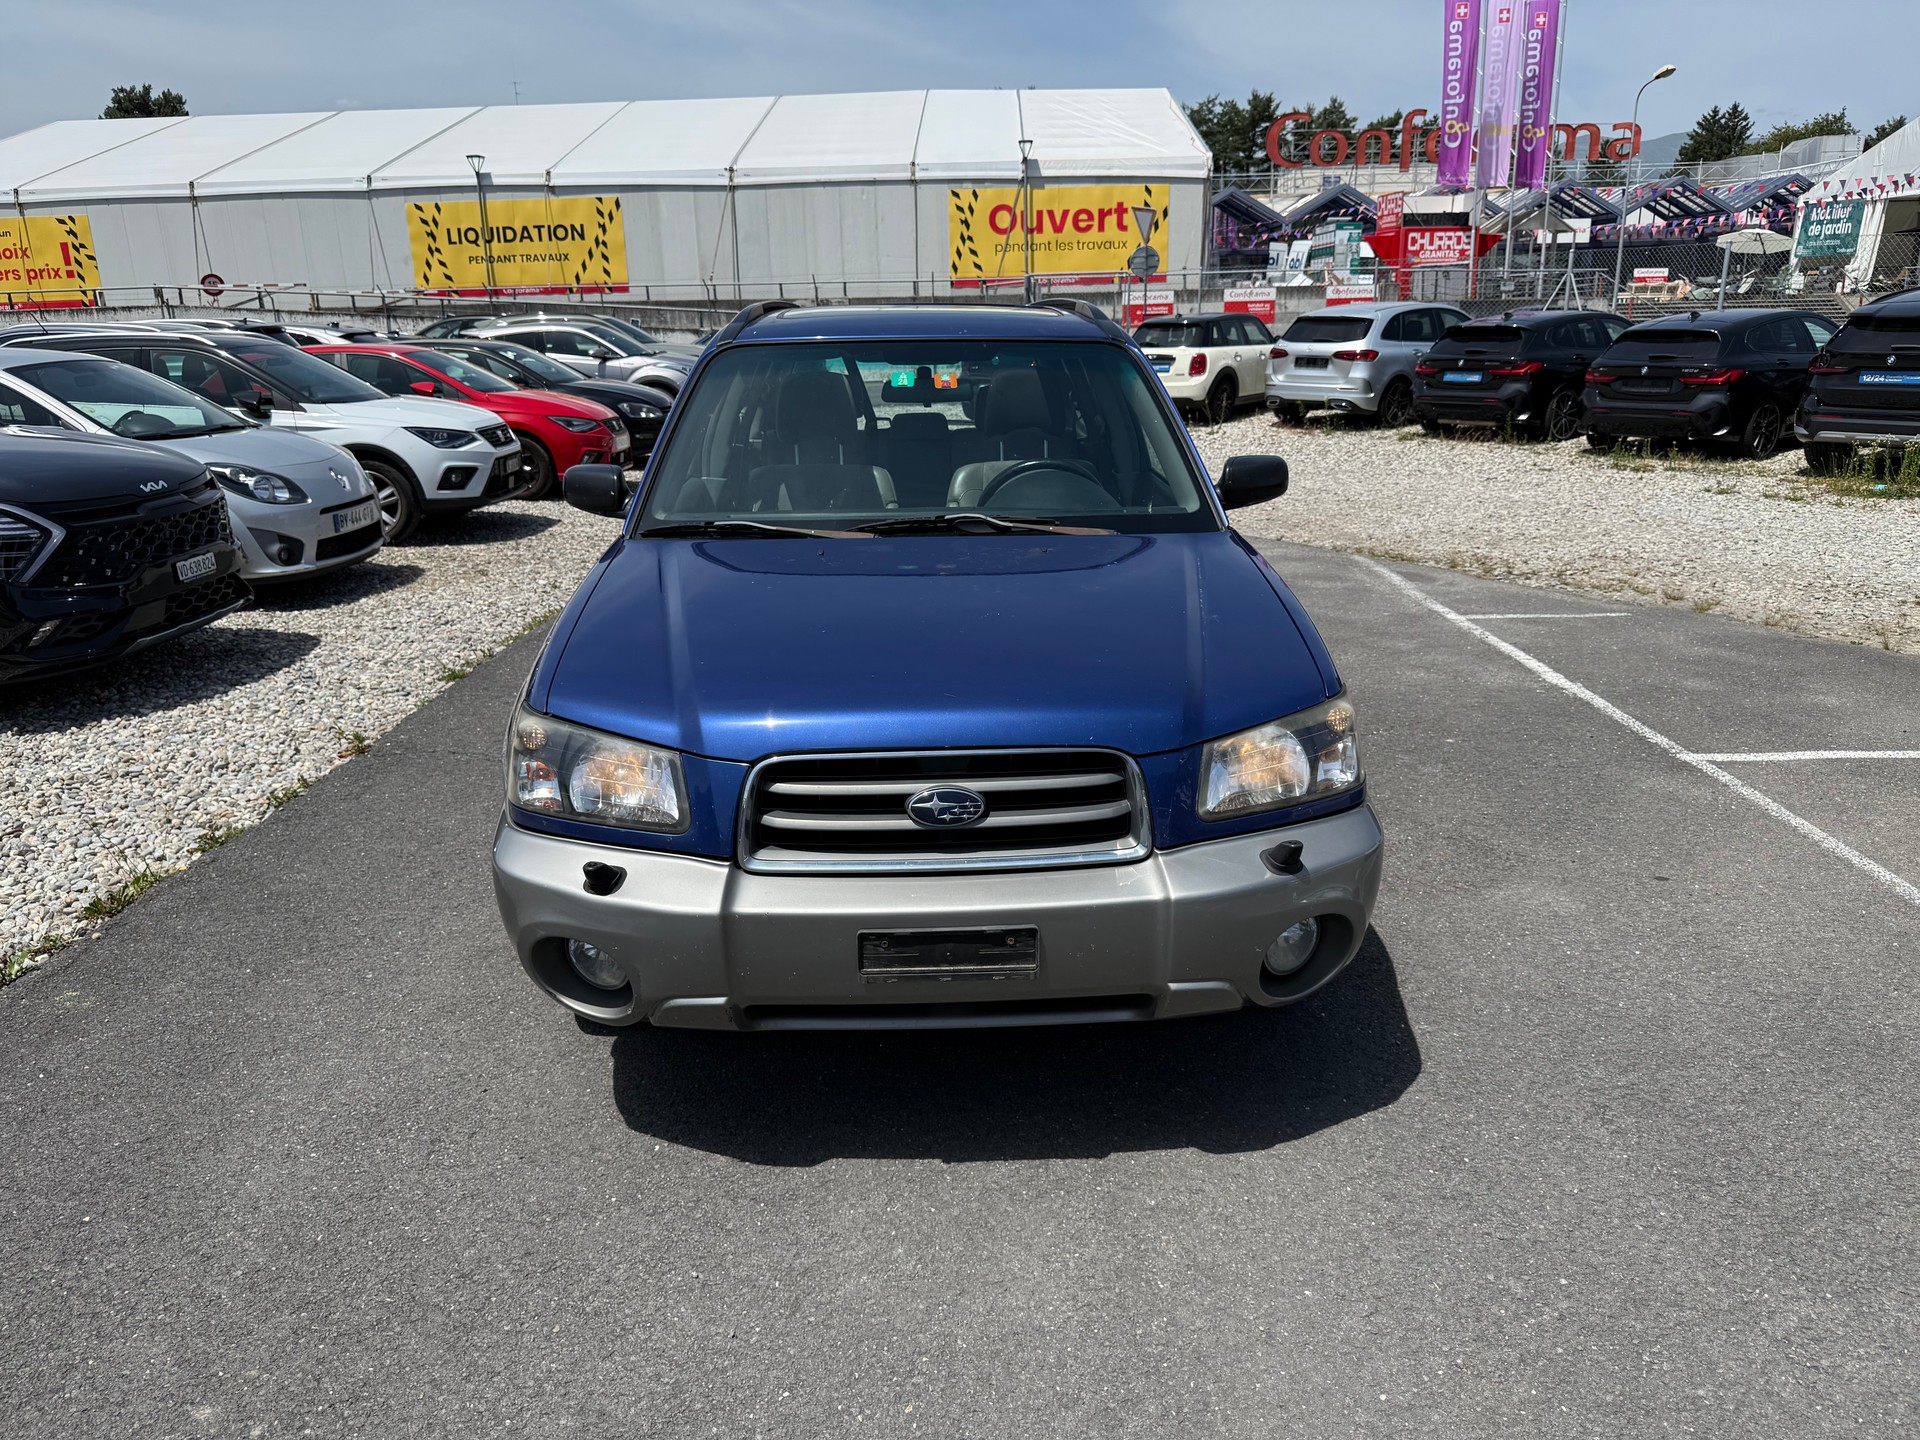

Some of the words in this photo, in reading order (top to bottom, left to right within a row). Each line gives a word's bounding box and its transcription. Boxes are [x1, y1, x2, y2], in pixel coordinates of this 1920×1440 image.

[988, 201, 1129, 236] Ouvert
[446, 223, 586, 247] LIQUIDATION
[1808, 222, 1821, 236] de
[1820, 219, 1852, 240] jardin
[994, 240, 1051, 256] pendant
[1055, 239, 1073, 251] les
[1076, 239, 1128, 250] travaux
[1408, 231, 1472, 251] CHURROS
[0, 243, 31, 260] oix
[468, 254, 517, 265] PENDANT
[519, 253, 570, 263] TRAVAUX
[1419, 250, 1460, 259] GRANITAS
[26, 263, 63, 285] prix
[1229, 289, 1271, 299] Conforama
[1863, 374, 1885, 382] 12/24
